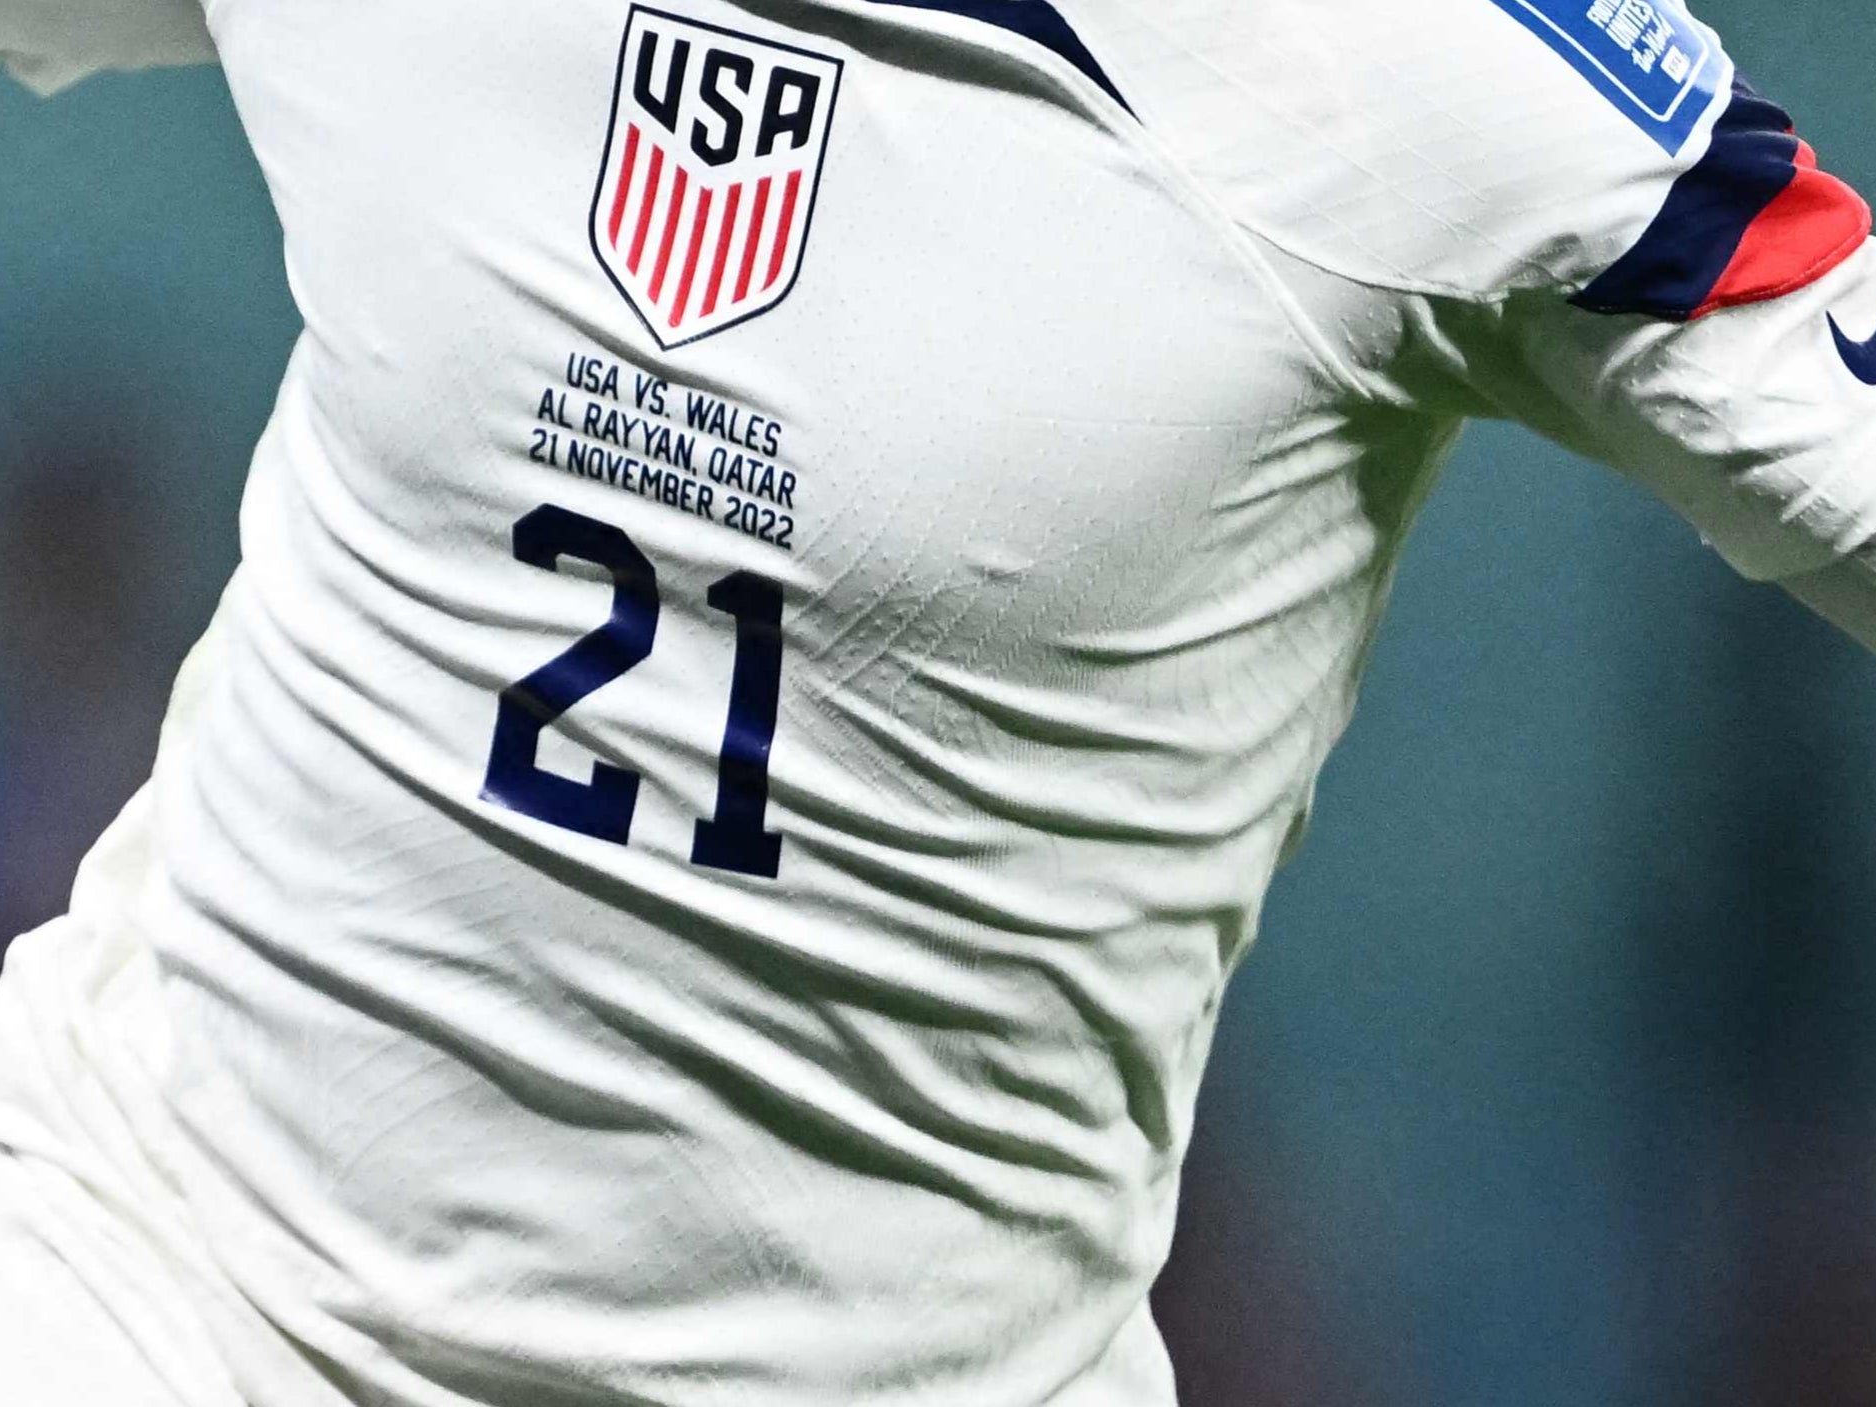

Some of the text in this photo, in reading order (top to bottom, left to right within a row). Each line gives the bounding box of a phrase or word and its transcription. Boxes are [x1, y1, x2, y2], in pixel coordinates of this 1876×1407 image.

[633, 29, 821, 167] USA
[538, 388, 573, 429] AL
[708, 447, 796, 510] QATAR
[566, 352, 782, 458] USA VS. WALES
[529, 428, 794, 550] 21 NOVEMBER 2022
[479, 503, 784, 879] 21
